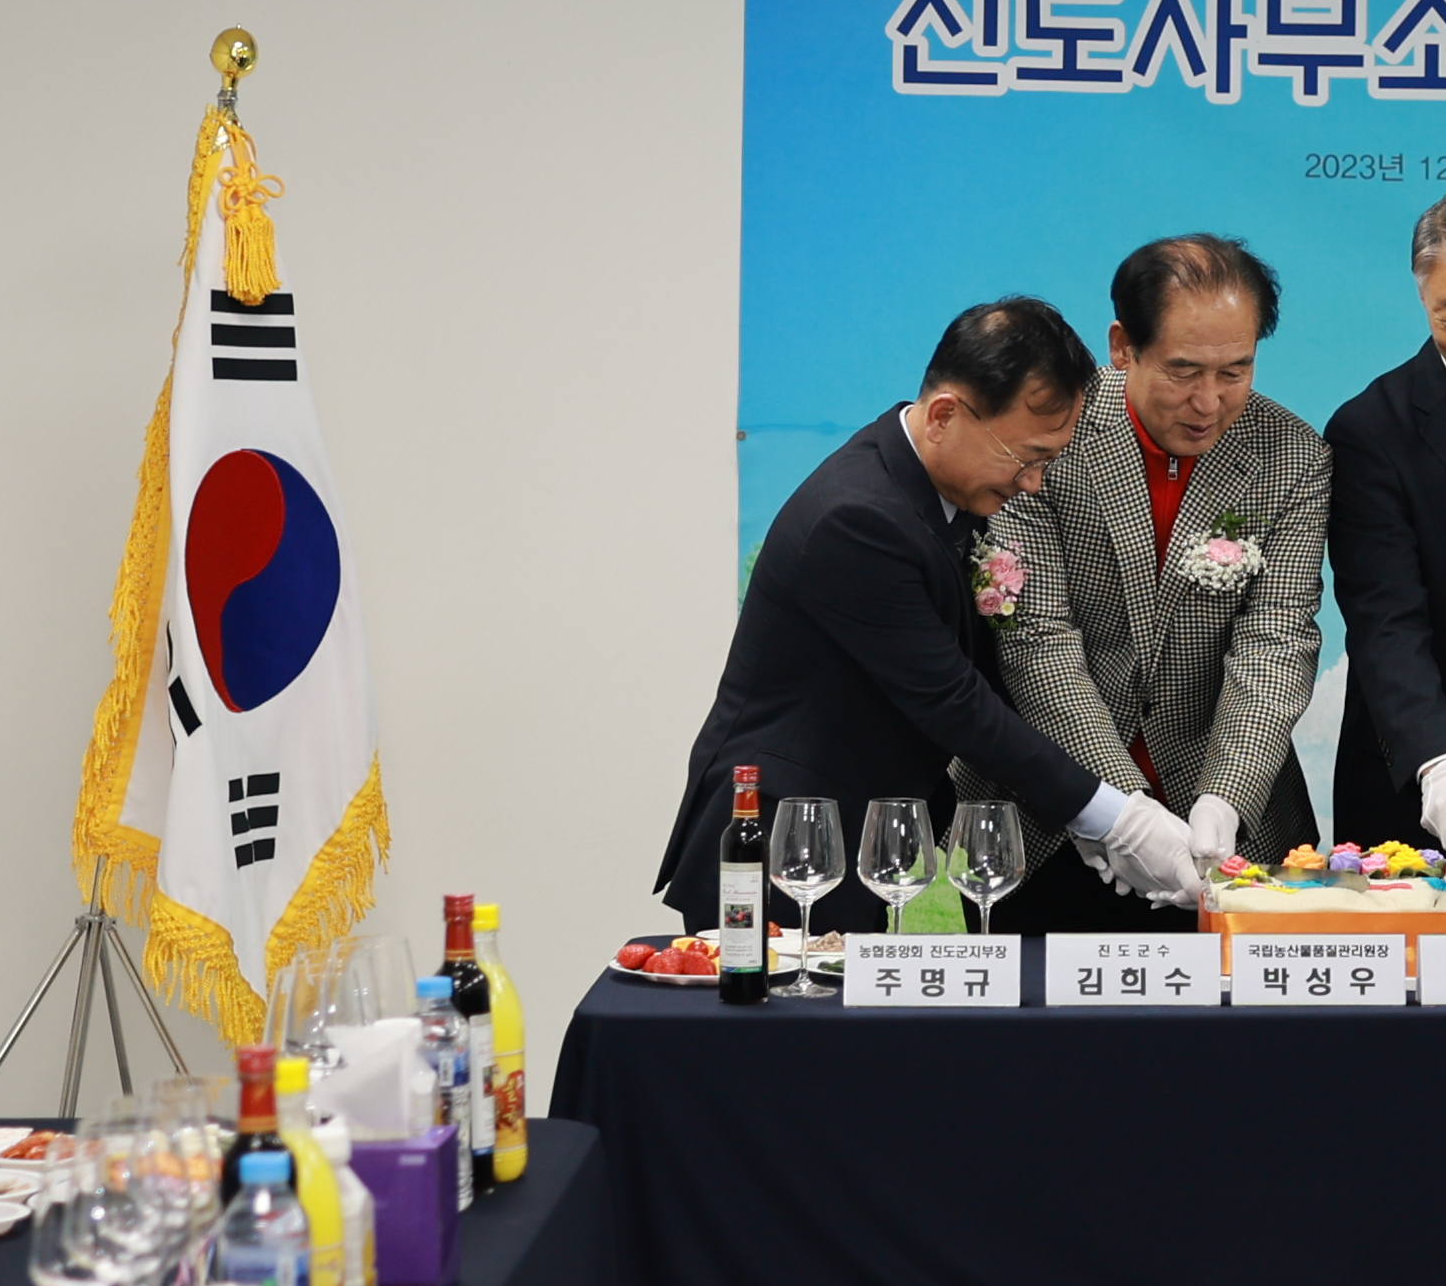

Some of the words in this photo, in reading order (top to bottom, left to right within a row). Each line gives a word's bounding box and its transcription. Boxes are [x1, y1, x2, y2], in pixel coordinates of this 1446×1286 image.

[1304, 152, 1405, 182] 2023년
[859, 944, 923, 959] 농협중앙회
[930, 945, 1008, 960] 진도군지부장
[1248, 944, 1390, 959] 국립농산물품질관리원장
